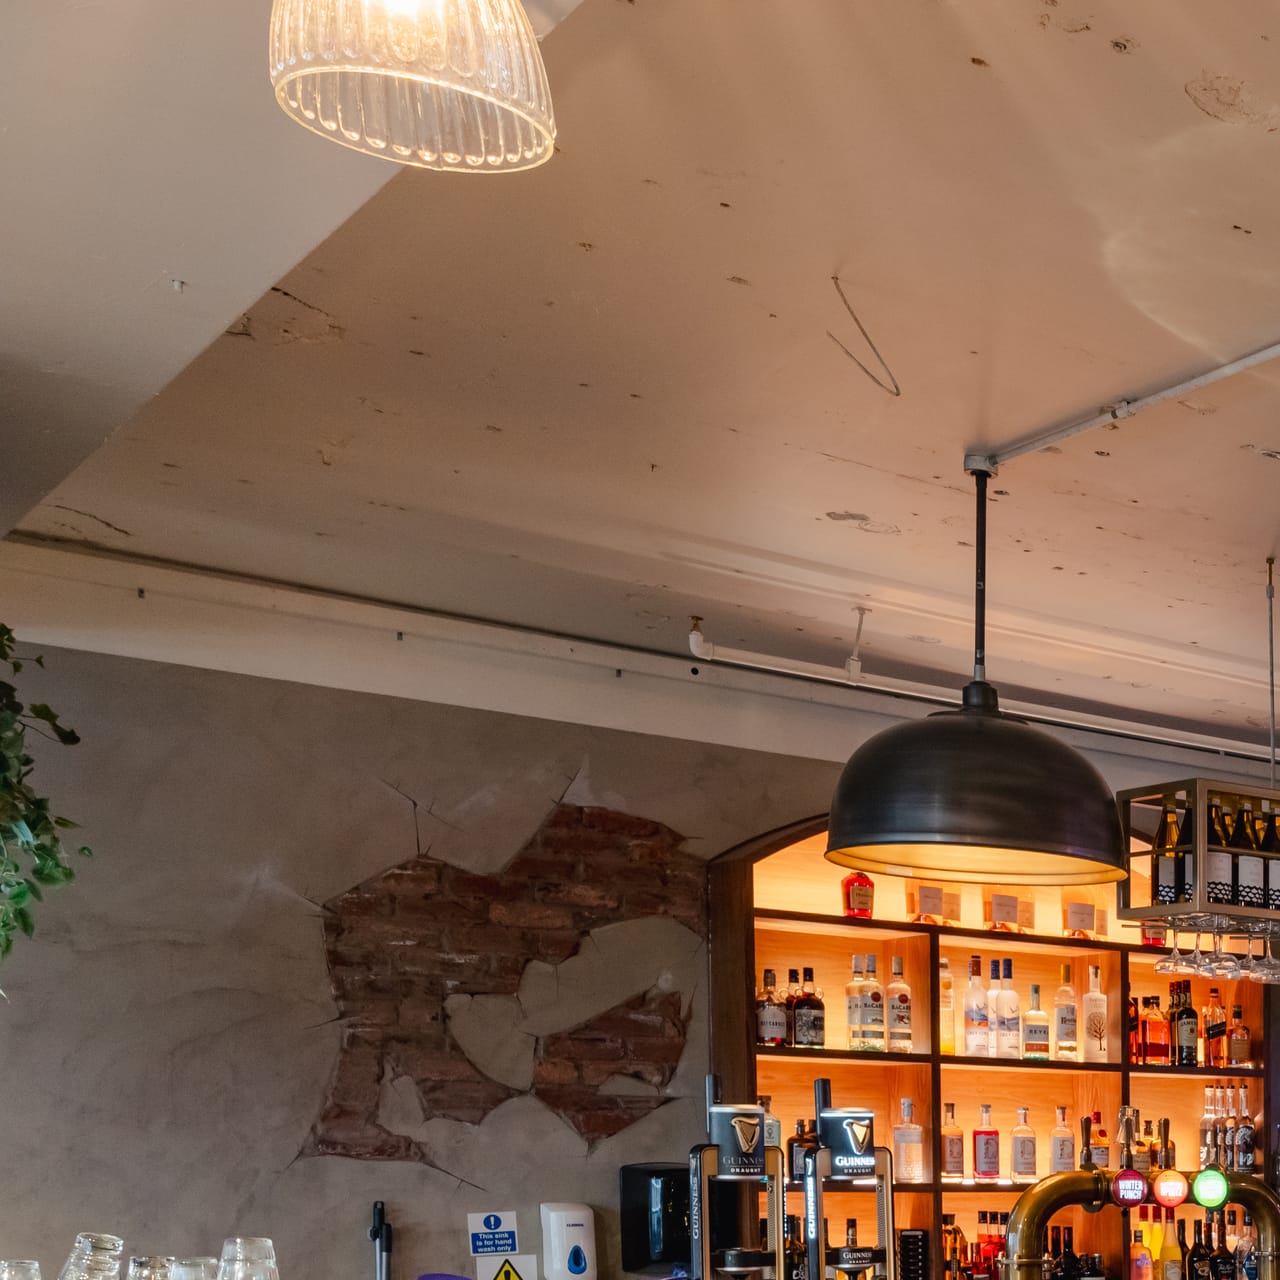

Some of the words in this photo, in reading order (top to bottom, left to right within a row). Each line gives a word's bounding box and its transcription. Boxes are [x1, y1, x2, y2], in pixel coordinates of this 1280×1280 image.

[834, 1155, 876, 1167] GUINNESS
[1118, 1180, 1143, 1190] WINTER
[1120, 1190, 1142, 1200] PUNCH
[692, 1176, 700, 1240] GUINNESS
[807, 1176, 817, 1239] GUINNESS
[497, 1245, 512, 1253] only
